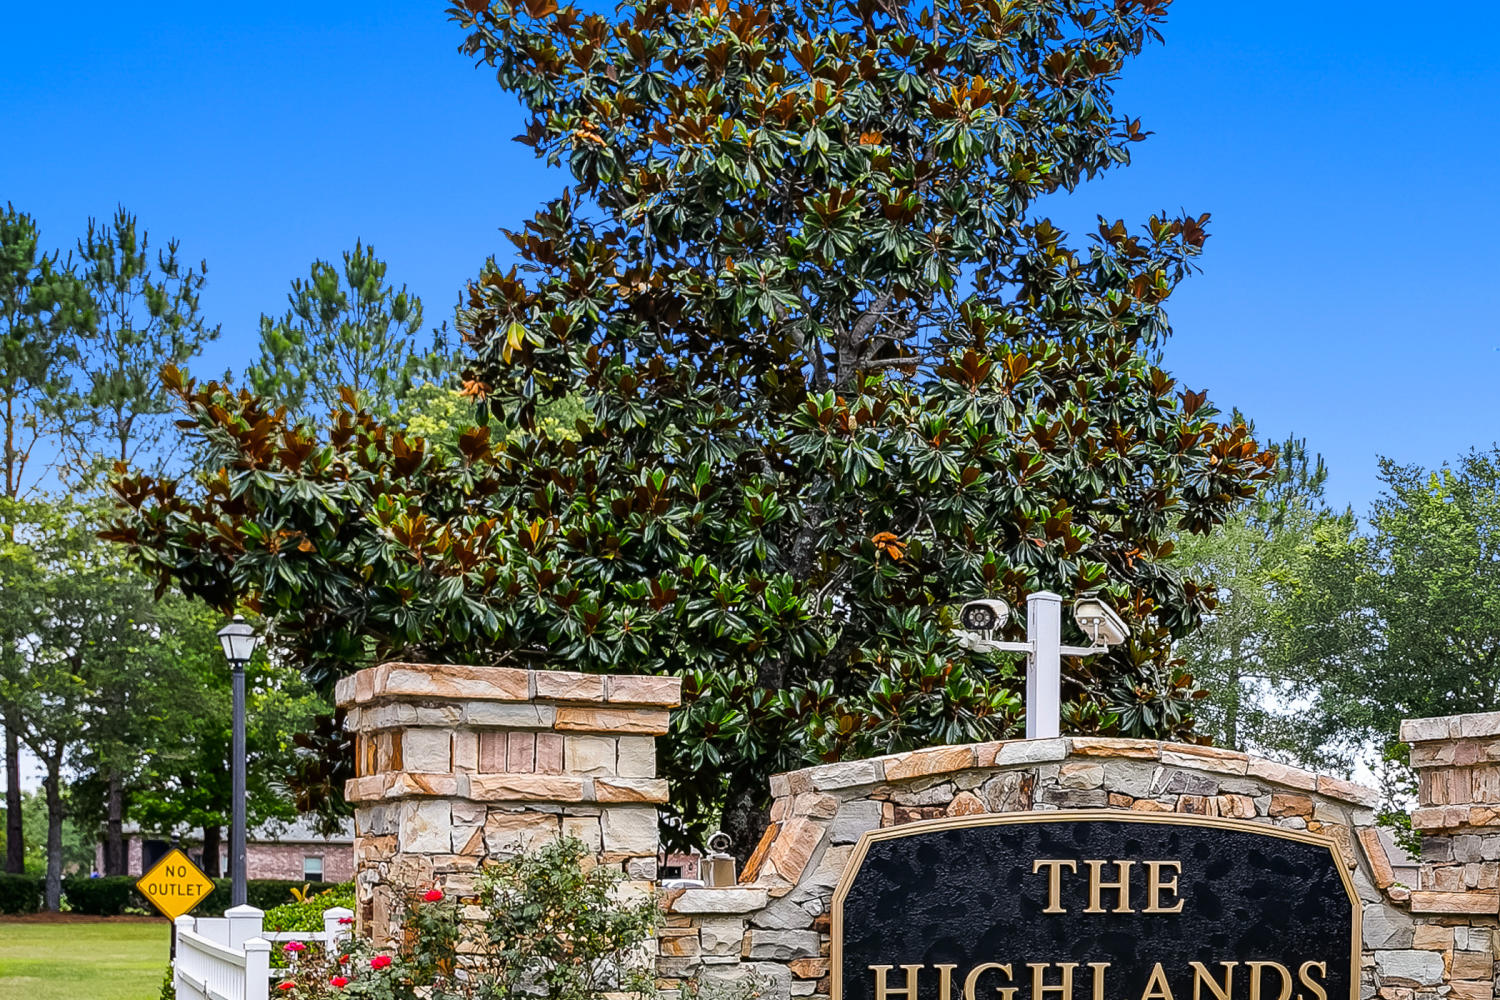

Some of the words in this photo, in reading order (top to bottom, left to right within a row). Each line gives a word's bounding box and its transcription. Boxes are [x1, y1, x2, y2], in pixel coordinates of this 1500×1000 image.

[165, 865, 187, 878] NO
[148, 883, 203, 896] OUTLET
[1032, 859, 1186, 914] THE
